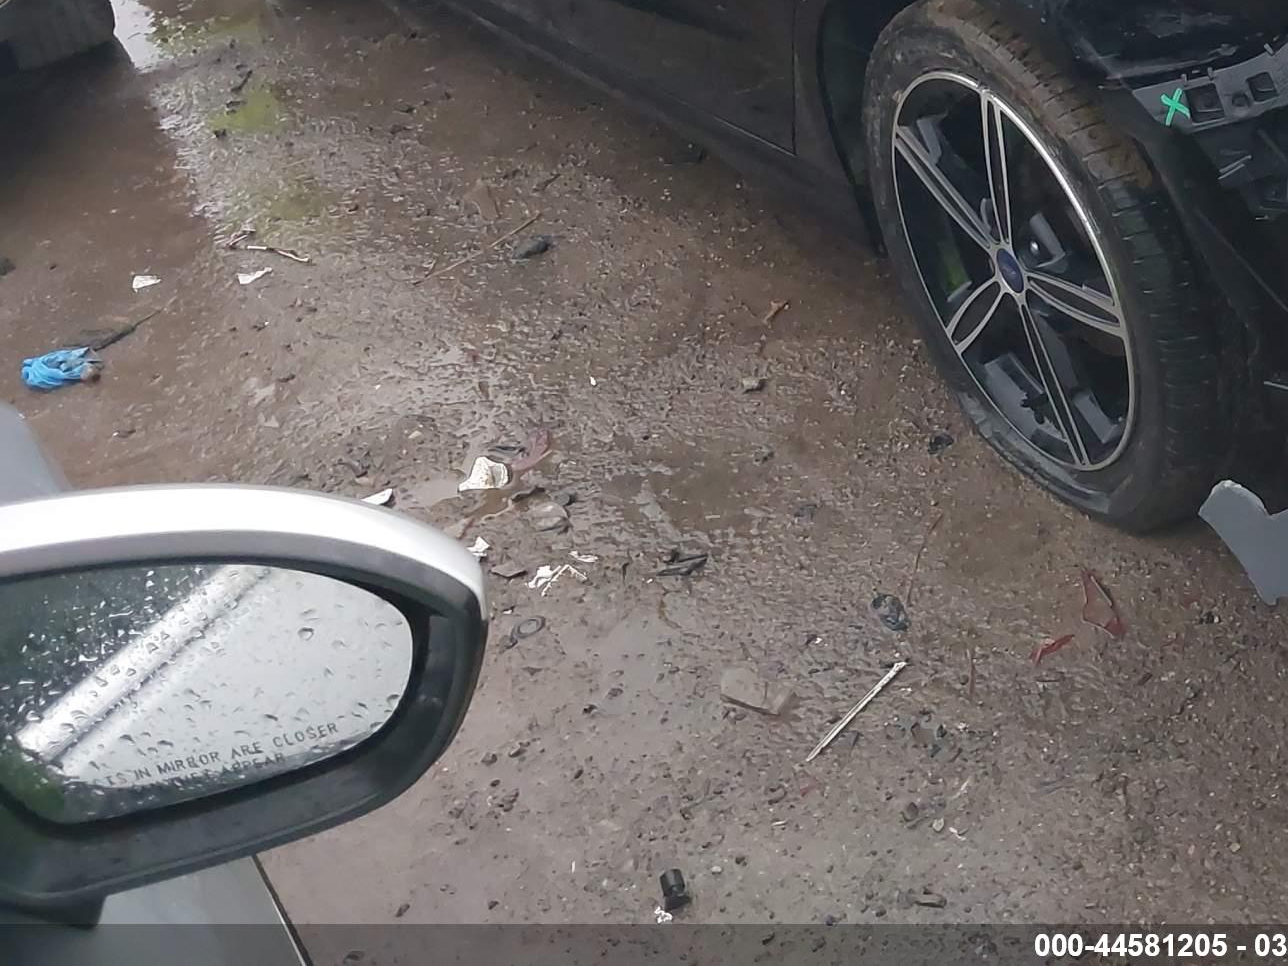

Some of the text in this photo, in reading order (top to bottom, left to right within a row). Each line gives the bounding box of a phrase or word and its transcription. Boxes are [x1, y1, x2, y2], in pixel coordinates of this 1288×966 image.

[156, 750, 221, 776] MIRROR
[230, 741, 264, 760] ARE
[272, 722, 340, 749] CLOSER
